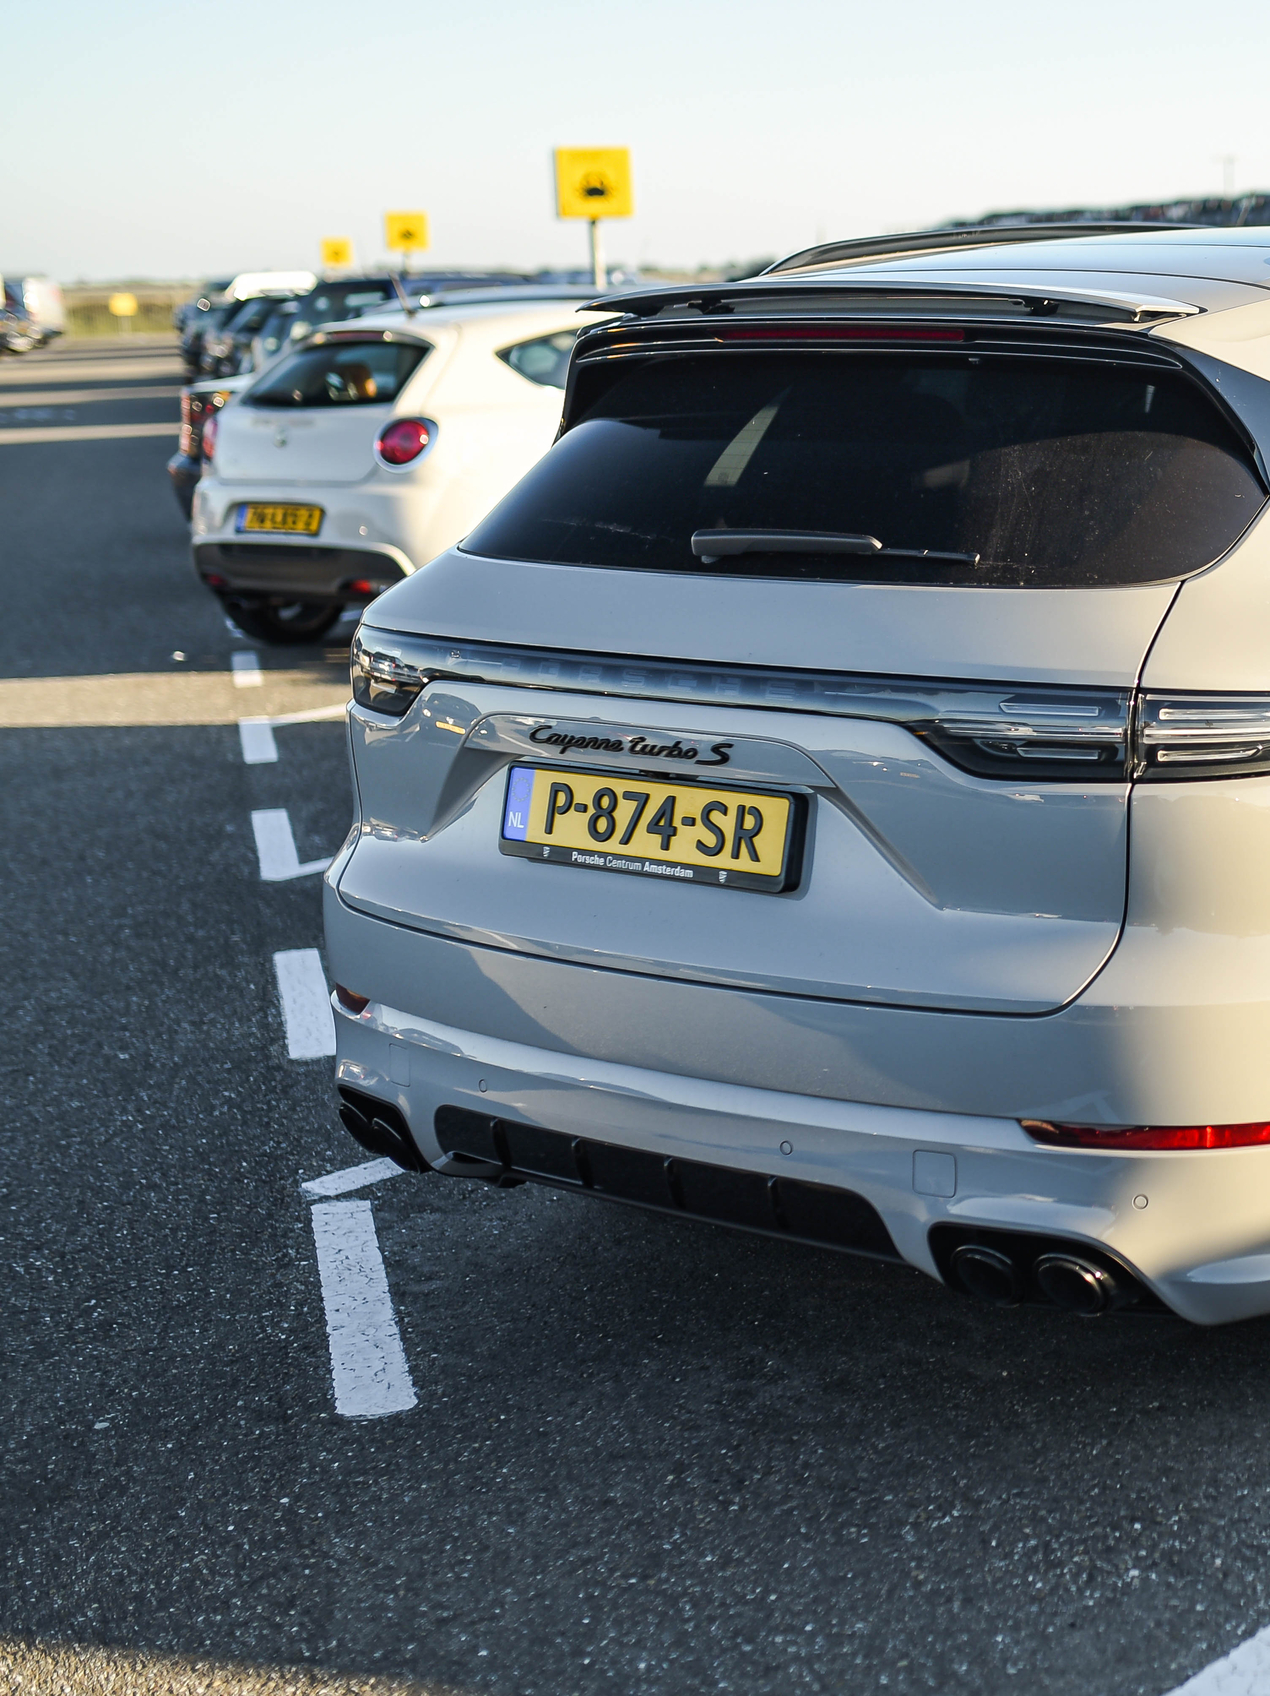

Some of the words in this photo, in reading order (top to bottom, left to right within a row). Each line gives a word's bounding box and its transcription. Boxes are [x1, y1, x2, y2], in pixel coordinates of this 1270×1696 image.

[529, 725, 624, 754] Cayenne
[694, 743, 734, 766] S
[508, 811, 525, 829] NL
[544, 782, 763, 863] P-874-SR
[571, 851, 605, 866] Porsche
[606, 856, 642, 871] Centrum
[643, 862, 694, 878] Amsterdam
